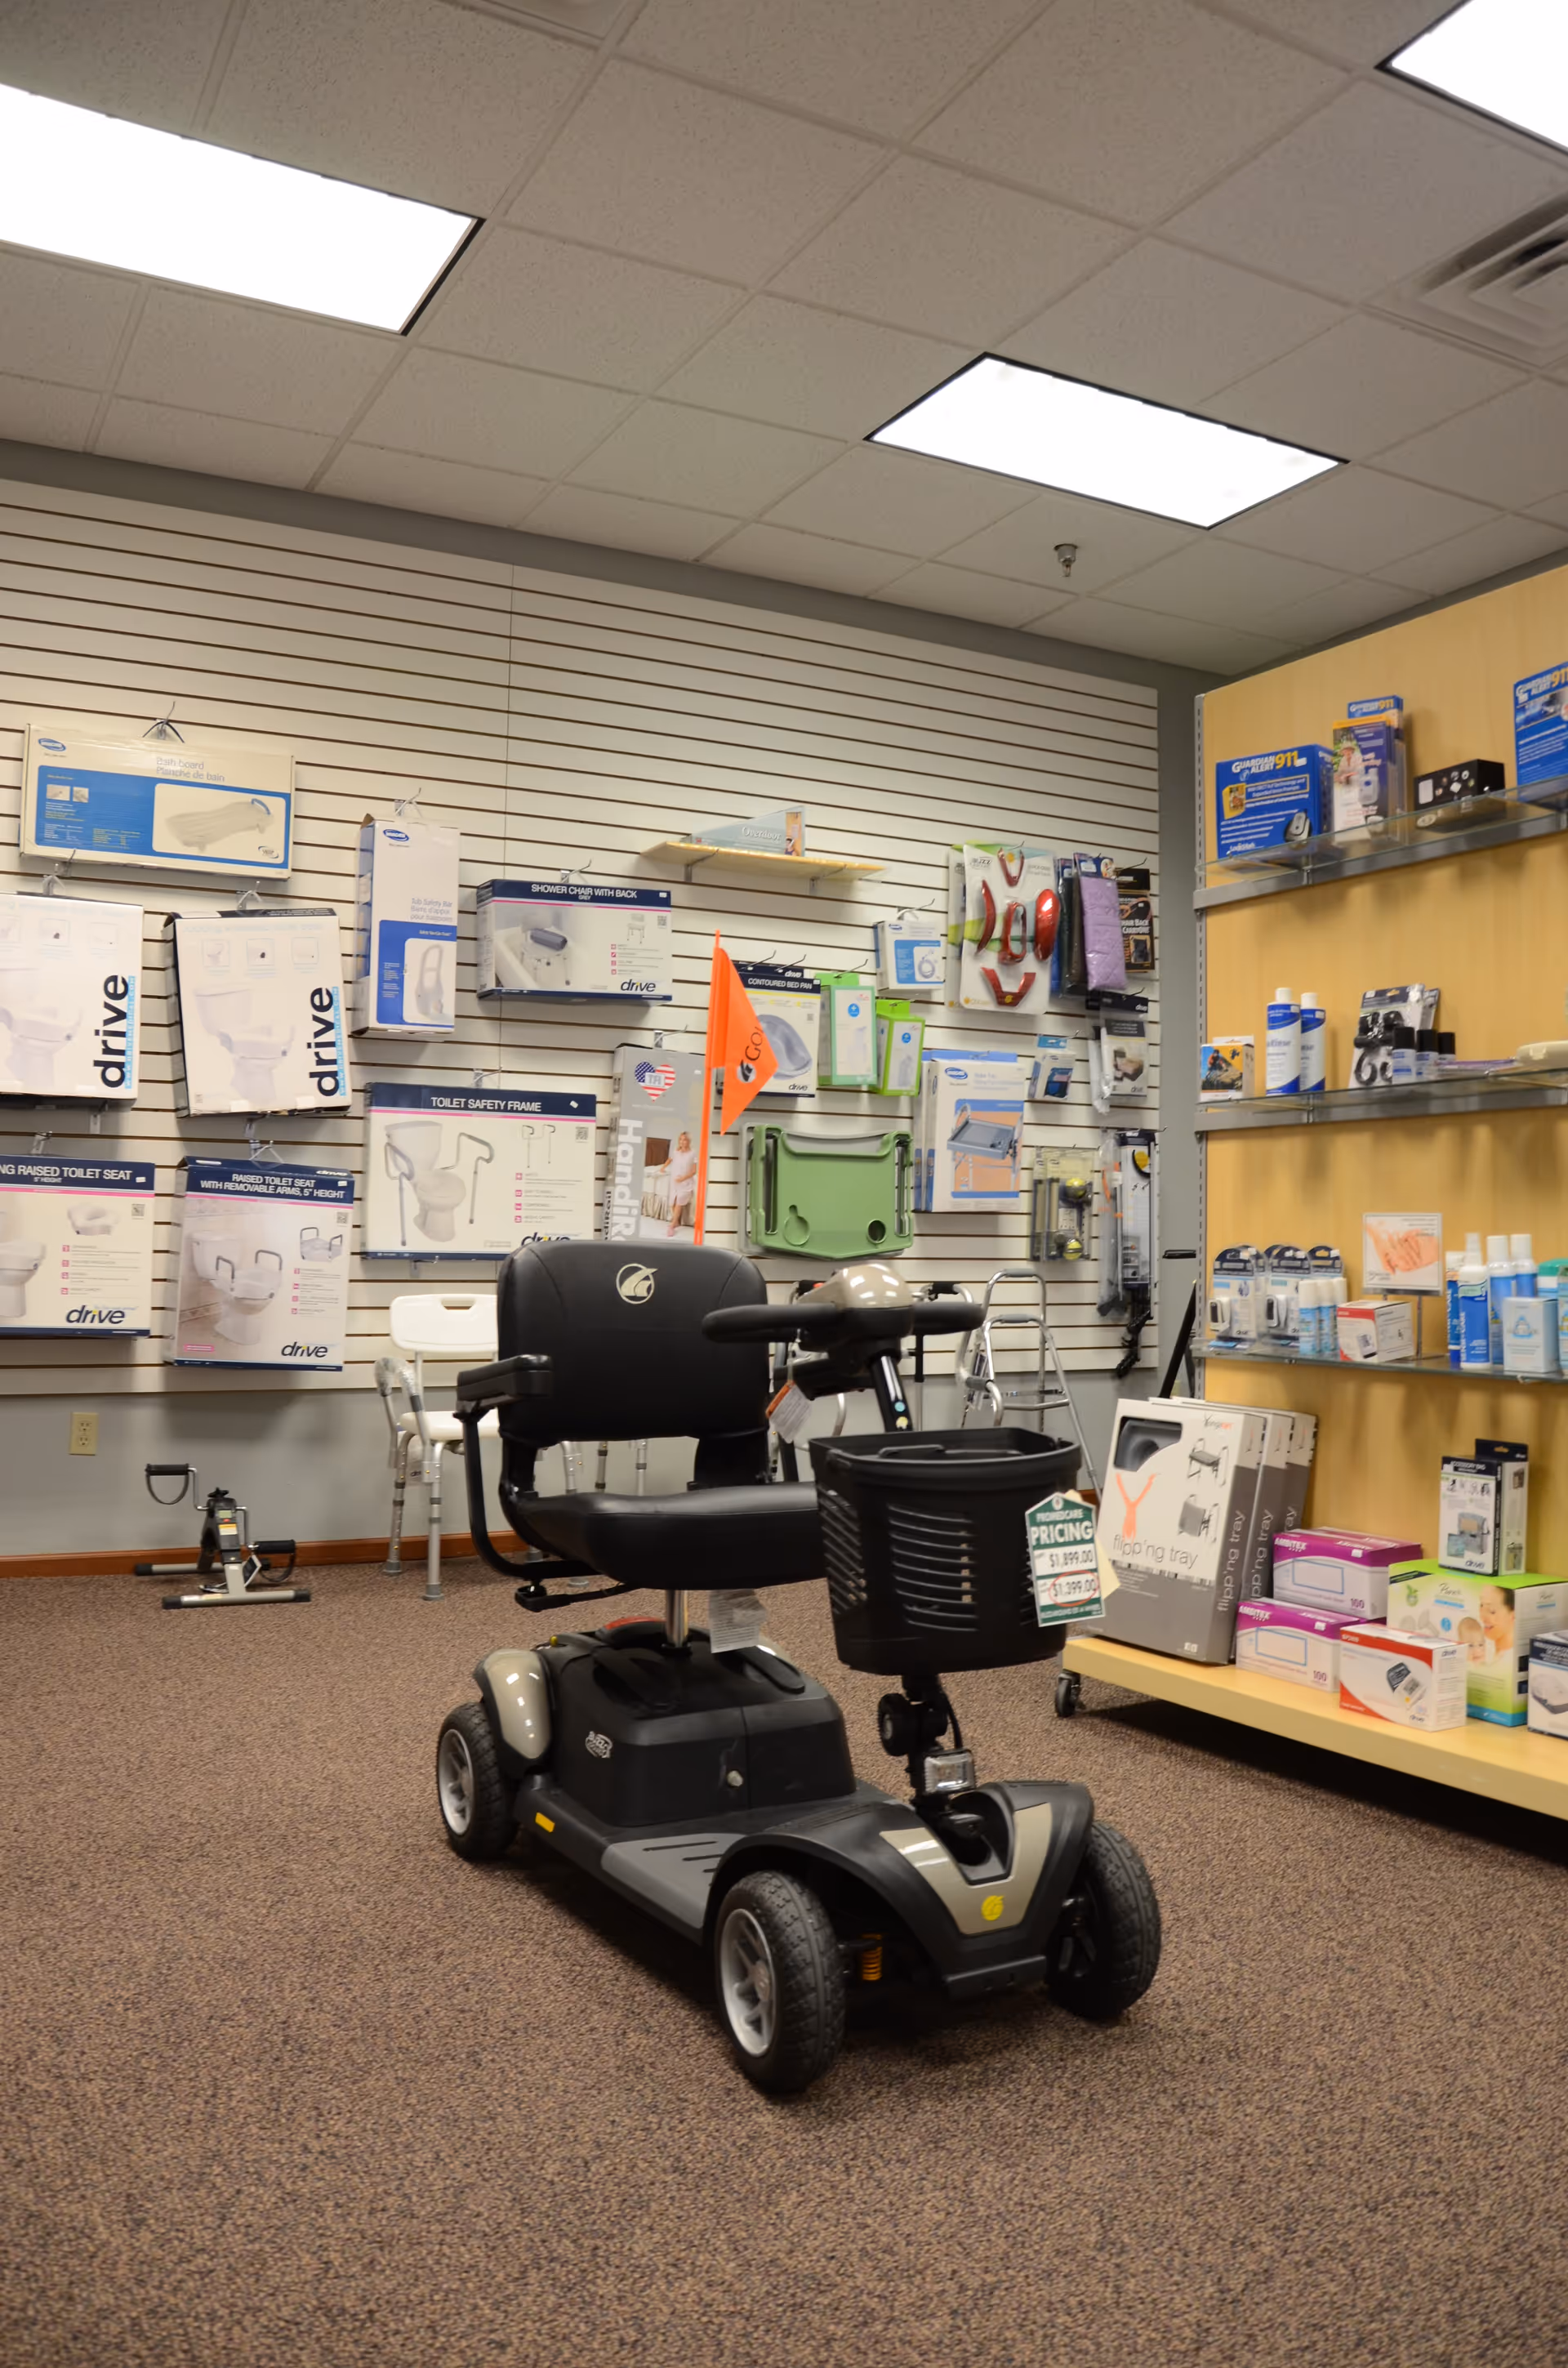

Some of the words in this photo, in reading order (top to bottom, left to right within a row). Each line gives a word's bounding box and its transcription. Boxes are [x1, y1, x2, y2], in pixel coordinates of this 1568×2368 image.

[1552, 667, 1568, 688] 91
[1378, 698, 1393, 710] 911
[178, 760, 204, 770] board
[1232, 755, 1275, 773] GUARDIAN
[1275, 751, 1298, 769] 911
[1250, 763, 1274, 774] ALERT
[156, 766, 189, 780] Planche
[192, 769, 204, 779] de
[207, 770, 225, 783] bain
[531, 884, 568, 894] SHOWER
[568, 886, 594, 895] CHAIR
[594, 888, 614, 897] WITH
[615, 890, 637, 899] BACK
[621, 979, 656, 992] drive
[747, 978, 786, 988] CONTOURED
[93, 974, 129, 1088] drive
[306, 987, 340, 1097] drive
[789, 1082, 809, 1092] drive
[431, 1097, 466, 1109] TOILET
[467, 1098, 506, 1112] SAFETY
[507, 1099, 541, 1113] FRAME
[18, 1165, 60, 1177] RAISED
[61, 1166, 102, 1180] TOILET
[103, 1169, 132, 1180] SEAT
[232, 1174, 263, 1184] RAISED
[264, 1176, 293, 1186] TOILET
[294, 1179, 316, 1188] SEAT
[612, 1118, 644, 1240] HandiR
[200, 1180, 223, 1189] WITH
[224, 1182, 275, 1194] REMOVABLE
[276, 1185, 303, 1197] ARMS,
[314, 1189, 345, 1198] HEIGHT
[66, 1304, 125, 1324] drive
[281, 1341, 328, 1358] drive
[1229, 1510, 1246, 1543] tray
[1258, 1509, 1274, 1541] tray
[1285, 1506, 1297, 1532] ray
[1031, 1520, 1094, 1546] PRICING
[1169, 1546, 1199, 1570] tray
[1351, 1599, 1365, 1609] 100
[1313, 1670, 1327, 1682] 100
